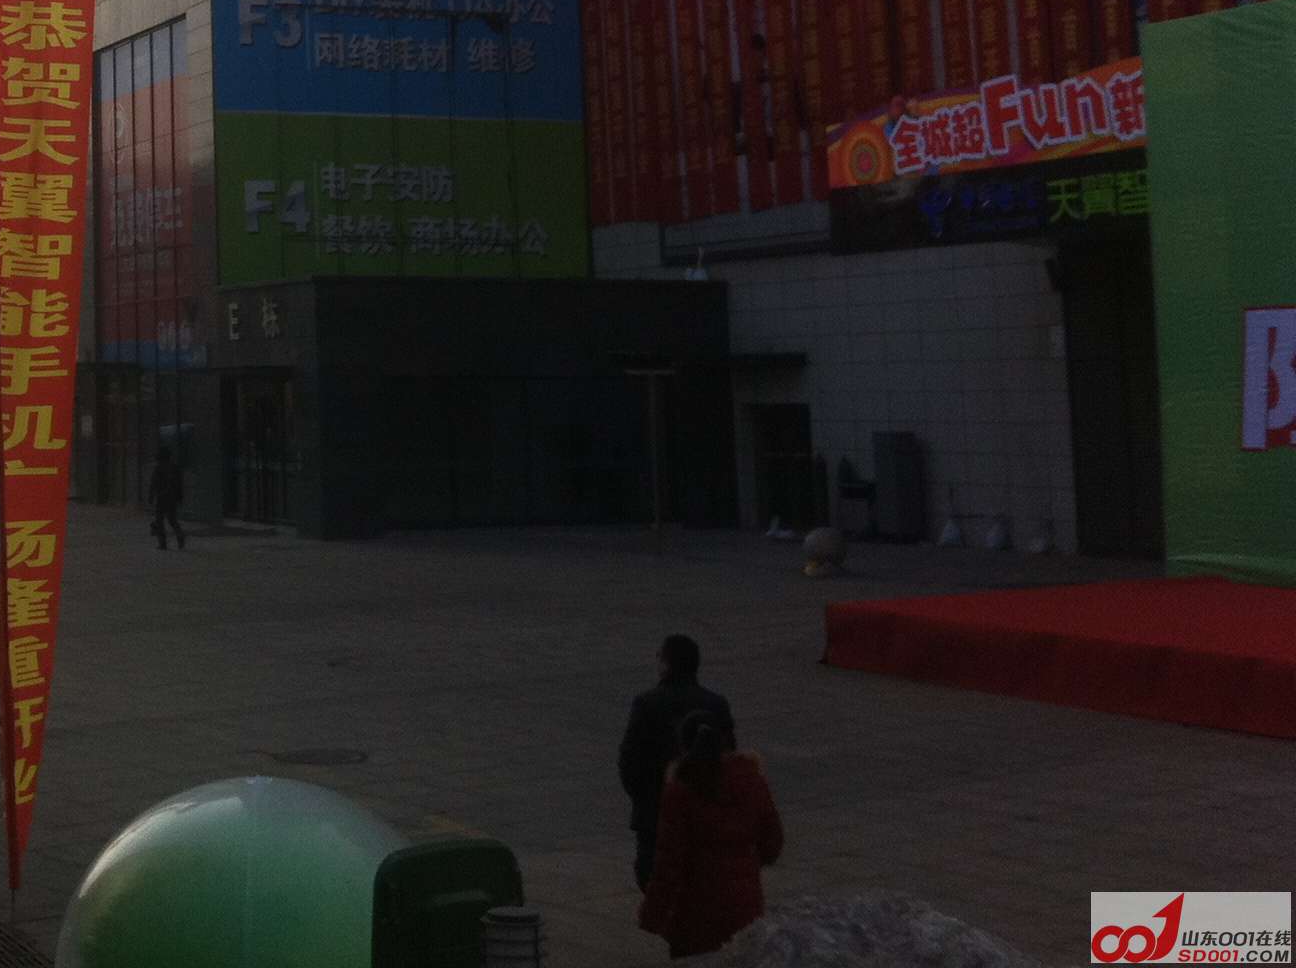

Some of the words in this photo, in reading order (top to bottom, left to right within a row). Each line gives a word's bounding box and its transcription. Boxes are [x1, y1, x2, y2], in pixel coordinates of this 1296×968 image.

[320, 163, 456, 202] 电子安防
[244, 179, 312, 233] F4
